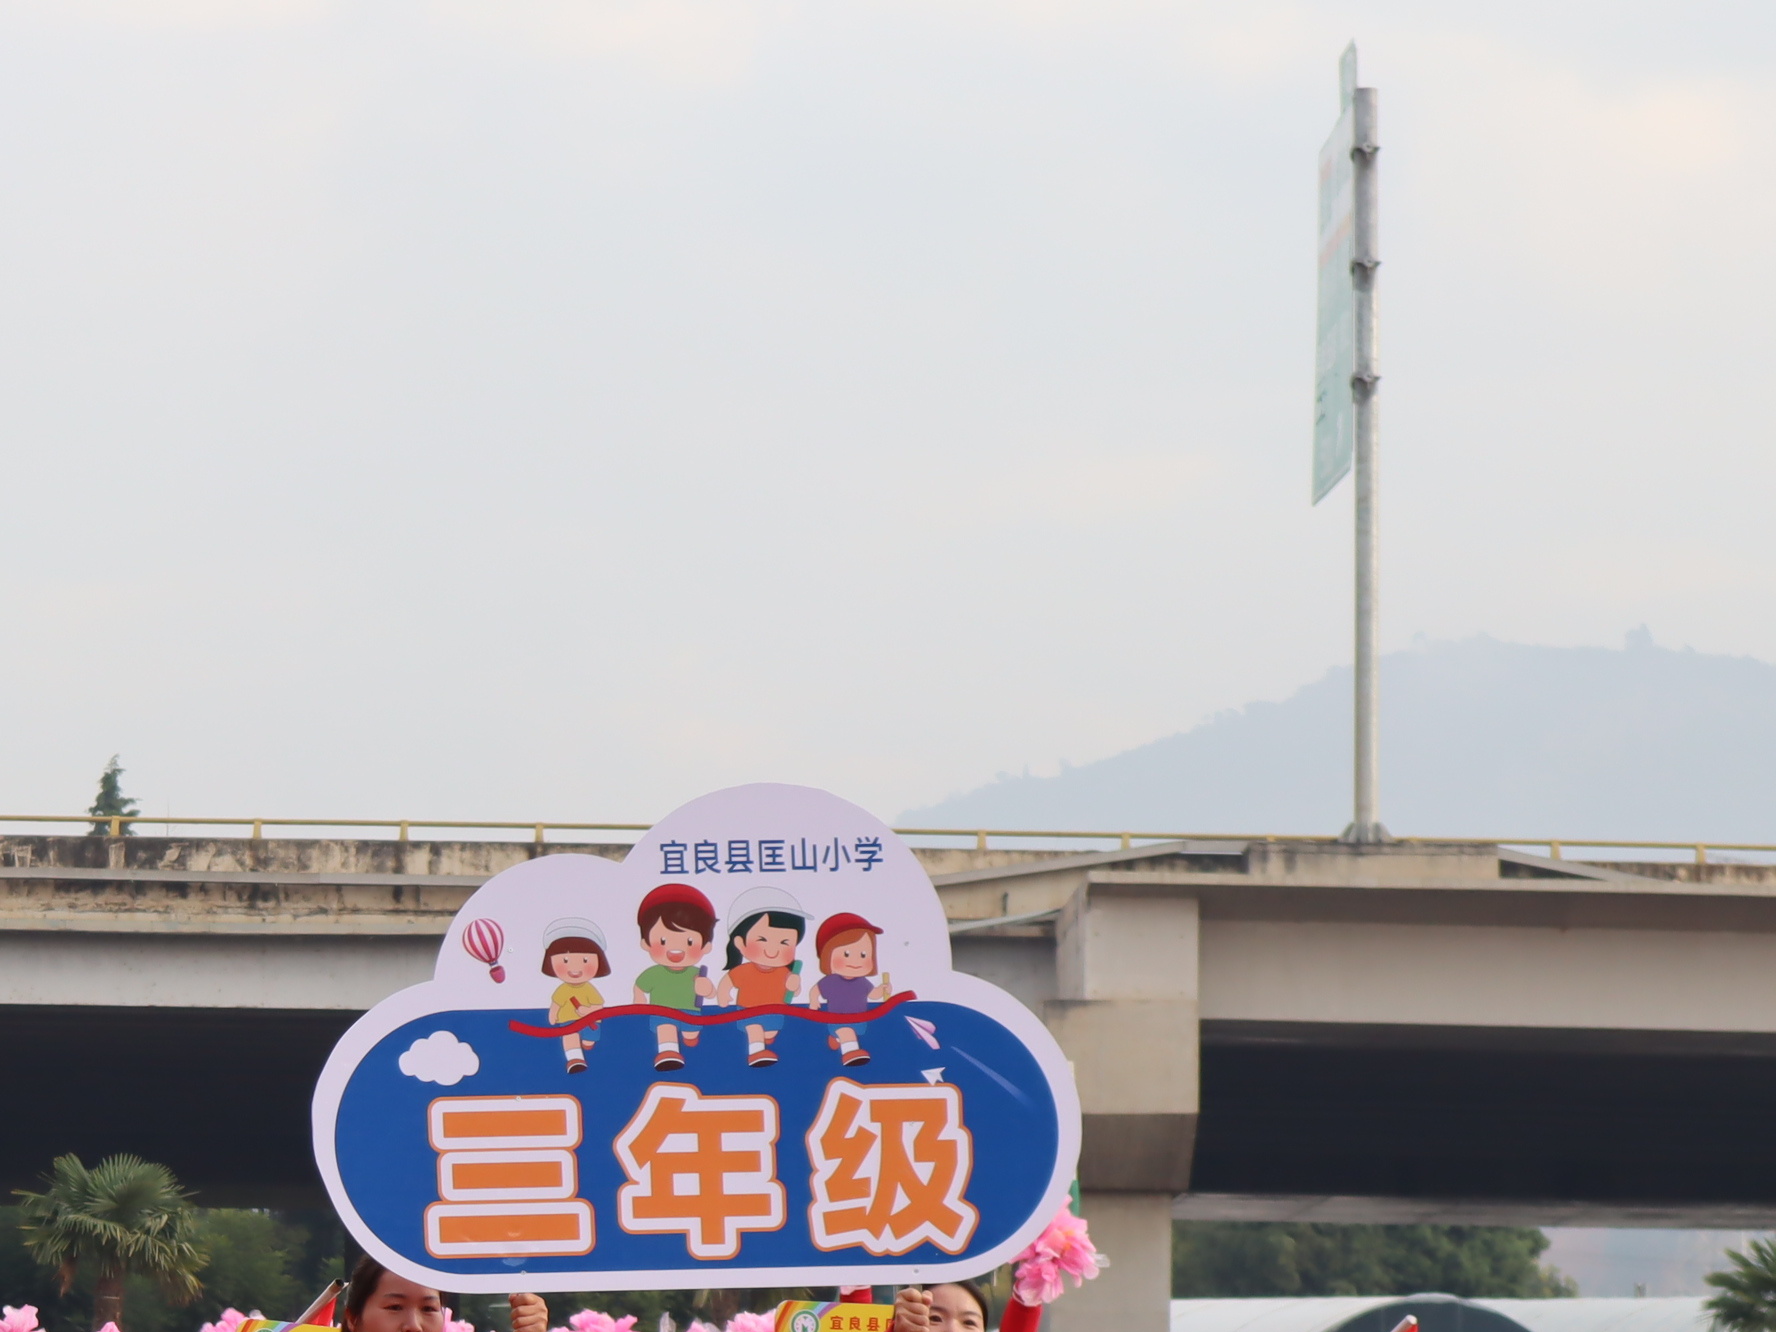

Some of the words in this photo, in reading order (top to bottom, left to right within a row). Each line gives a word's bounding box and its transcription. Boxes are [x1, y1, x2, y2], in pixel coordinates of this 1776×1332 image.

[659, 836, 884, 876] 宜良县匡山小学
[426, 1078, 979, 1260] 三年级
